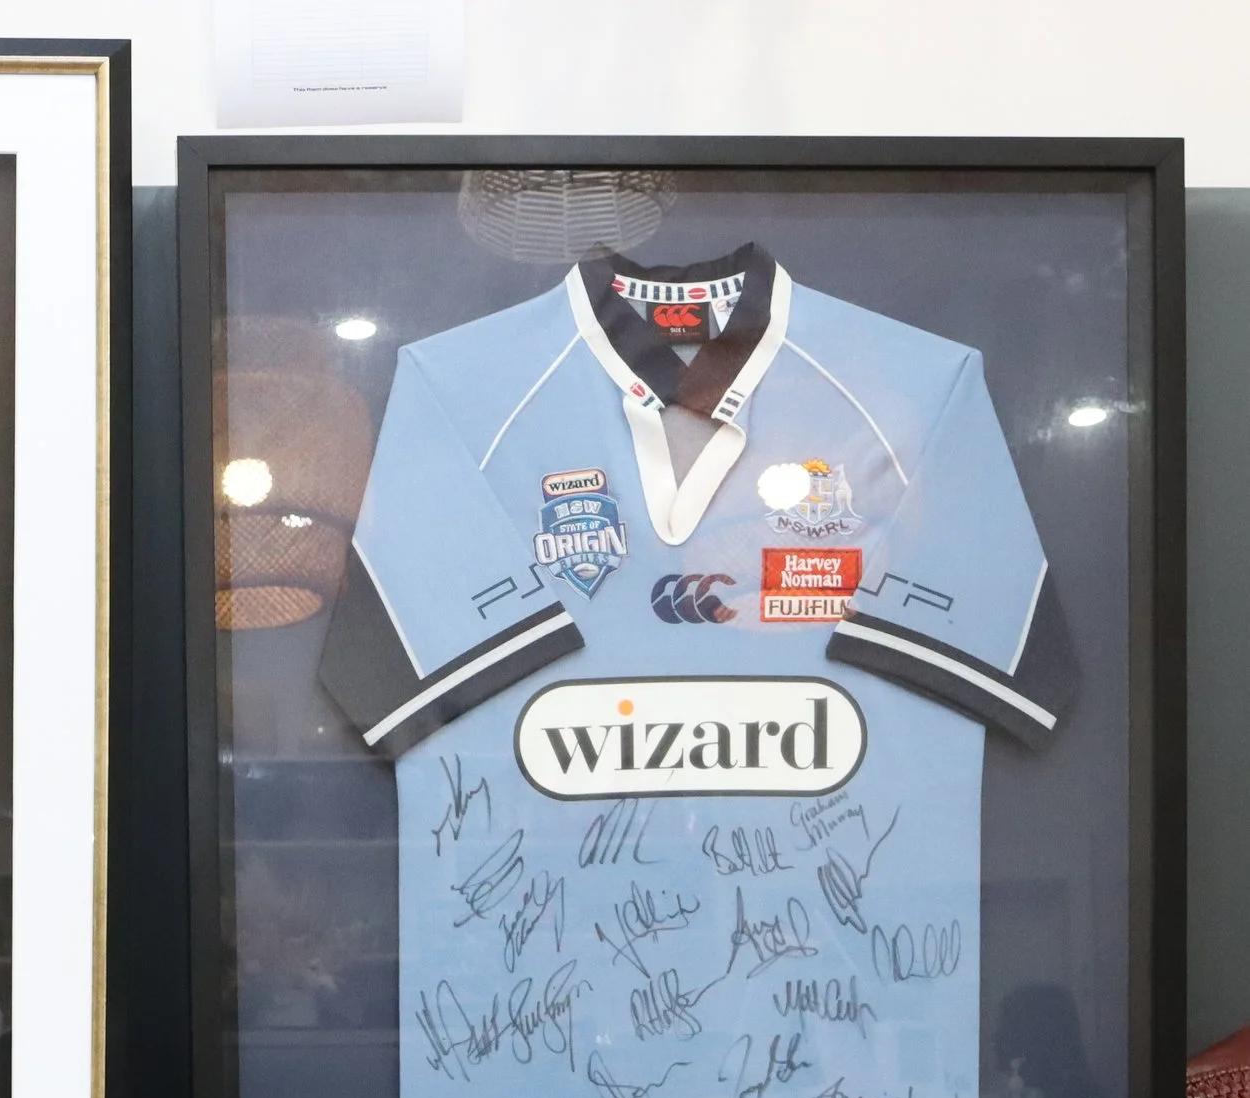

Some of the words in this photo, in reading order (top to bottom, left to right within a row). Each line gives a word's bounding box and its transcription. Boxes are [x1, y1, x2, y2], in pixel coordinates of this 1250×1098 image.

[548, 473, 600, 492] wizard
[554, 500, 602, 519] NSW
[560, 522, 587, 533] STATE
[589, 521, 601, 530] OF
[533, 523, 628, 566] ORIGIN
[784, 555, 842, 573] Harvey
[781, 571, 842, 588] Norman
[541, 697, 834, 774] wizard
